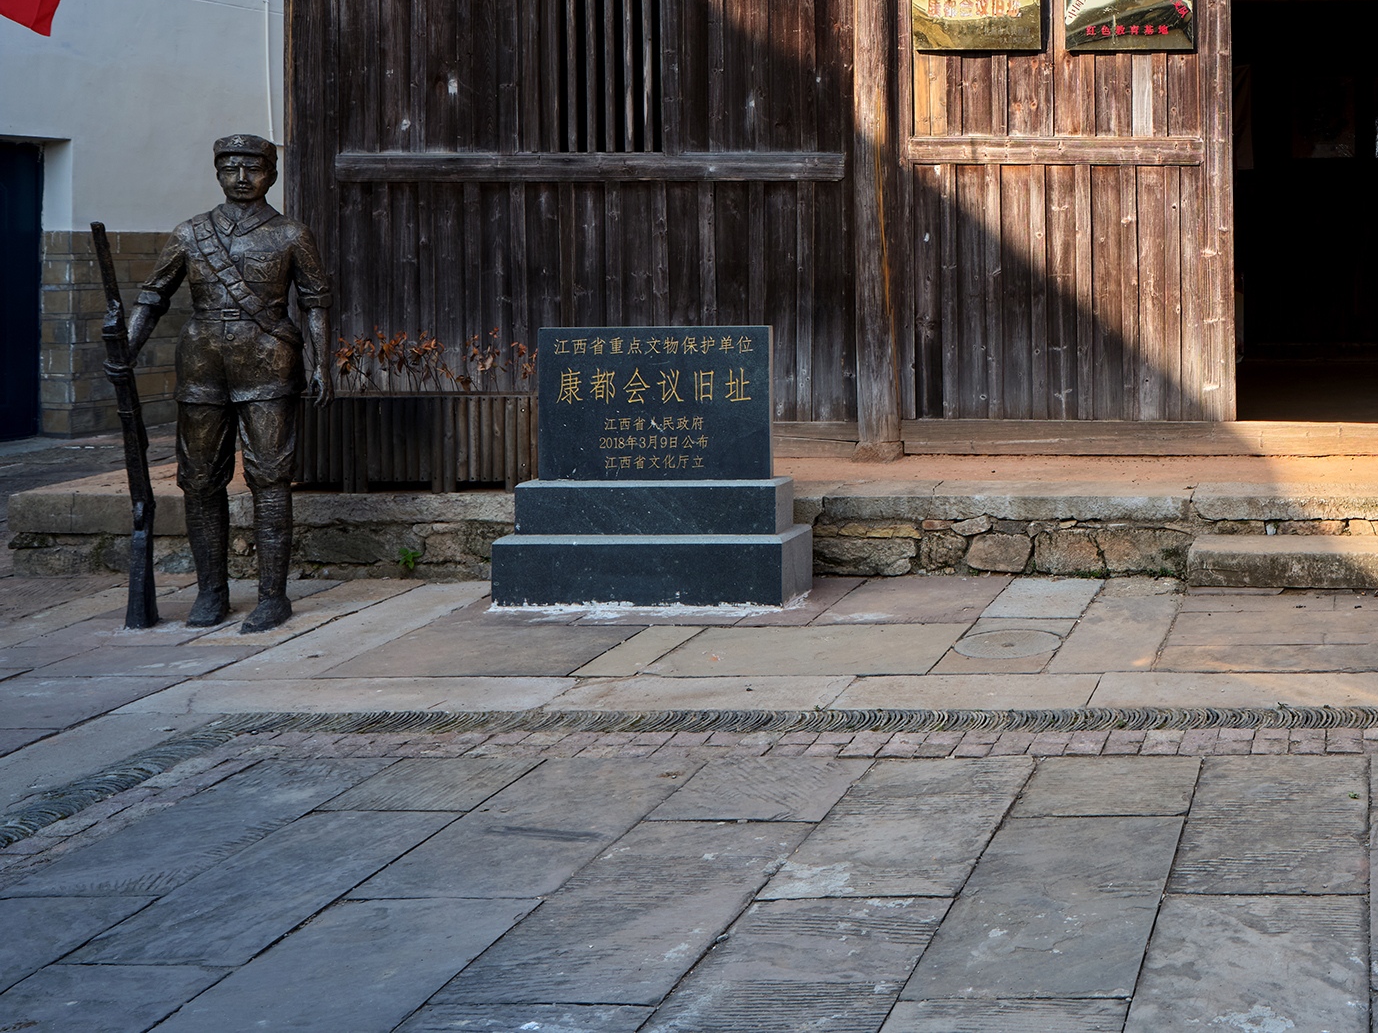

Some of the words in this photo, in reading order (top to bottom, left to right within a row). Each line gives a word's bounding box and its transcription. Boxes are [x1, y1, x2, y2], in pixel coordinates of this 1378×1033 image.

[1086, 24, 1169, 36] 红色教育基地
[553, 335, 754, 355] 江西省重点文物保护单位
[556, 367, 752, 405] 康都会议旧址
[603, 416, 705, 432] 江西省人民政府
[598, 434, 709, 450] 2018年3月9日公布
[604, 454, 705, 470] 江西省文化厅立
